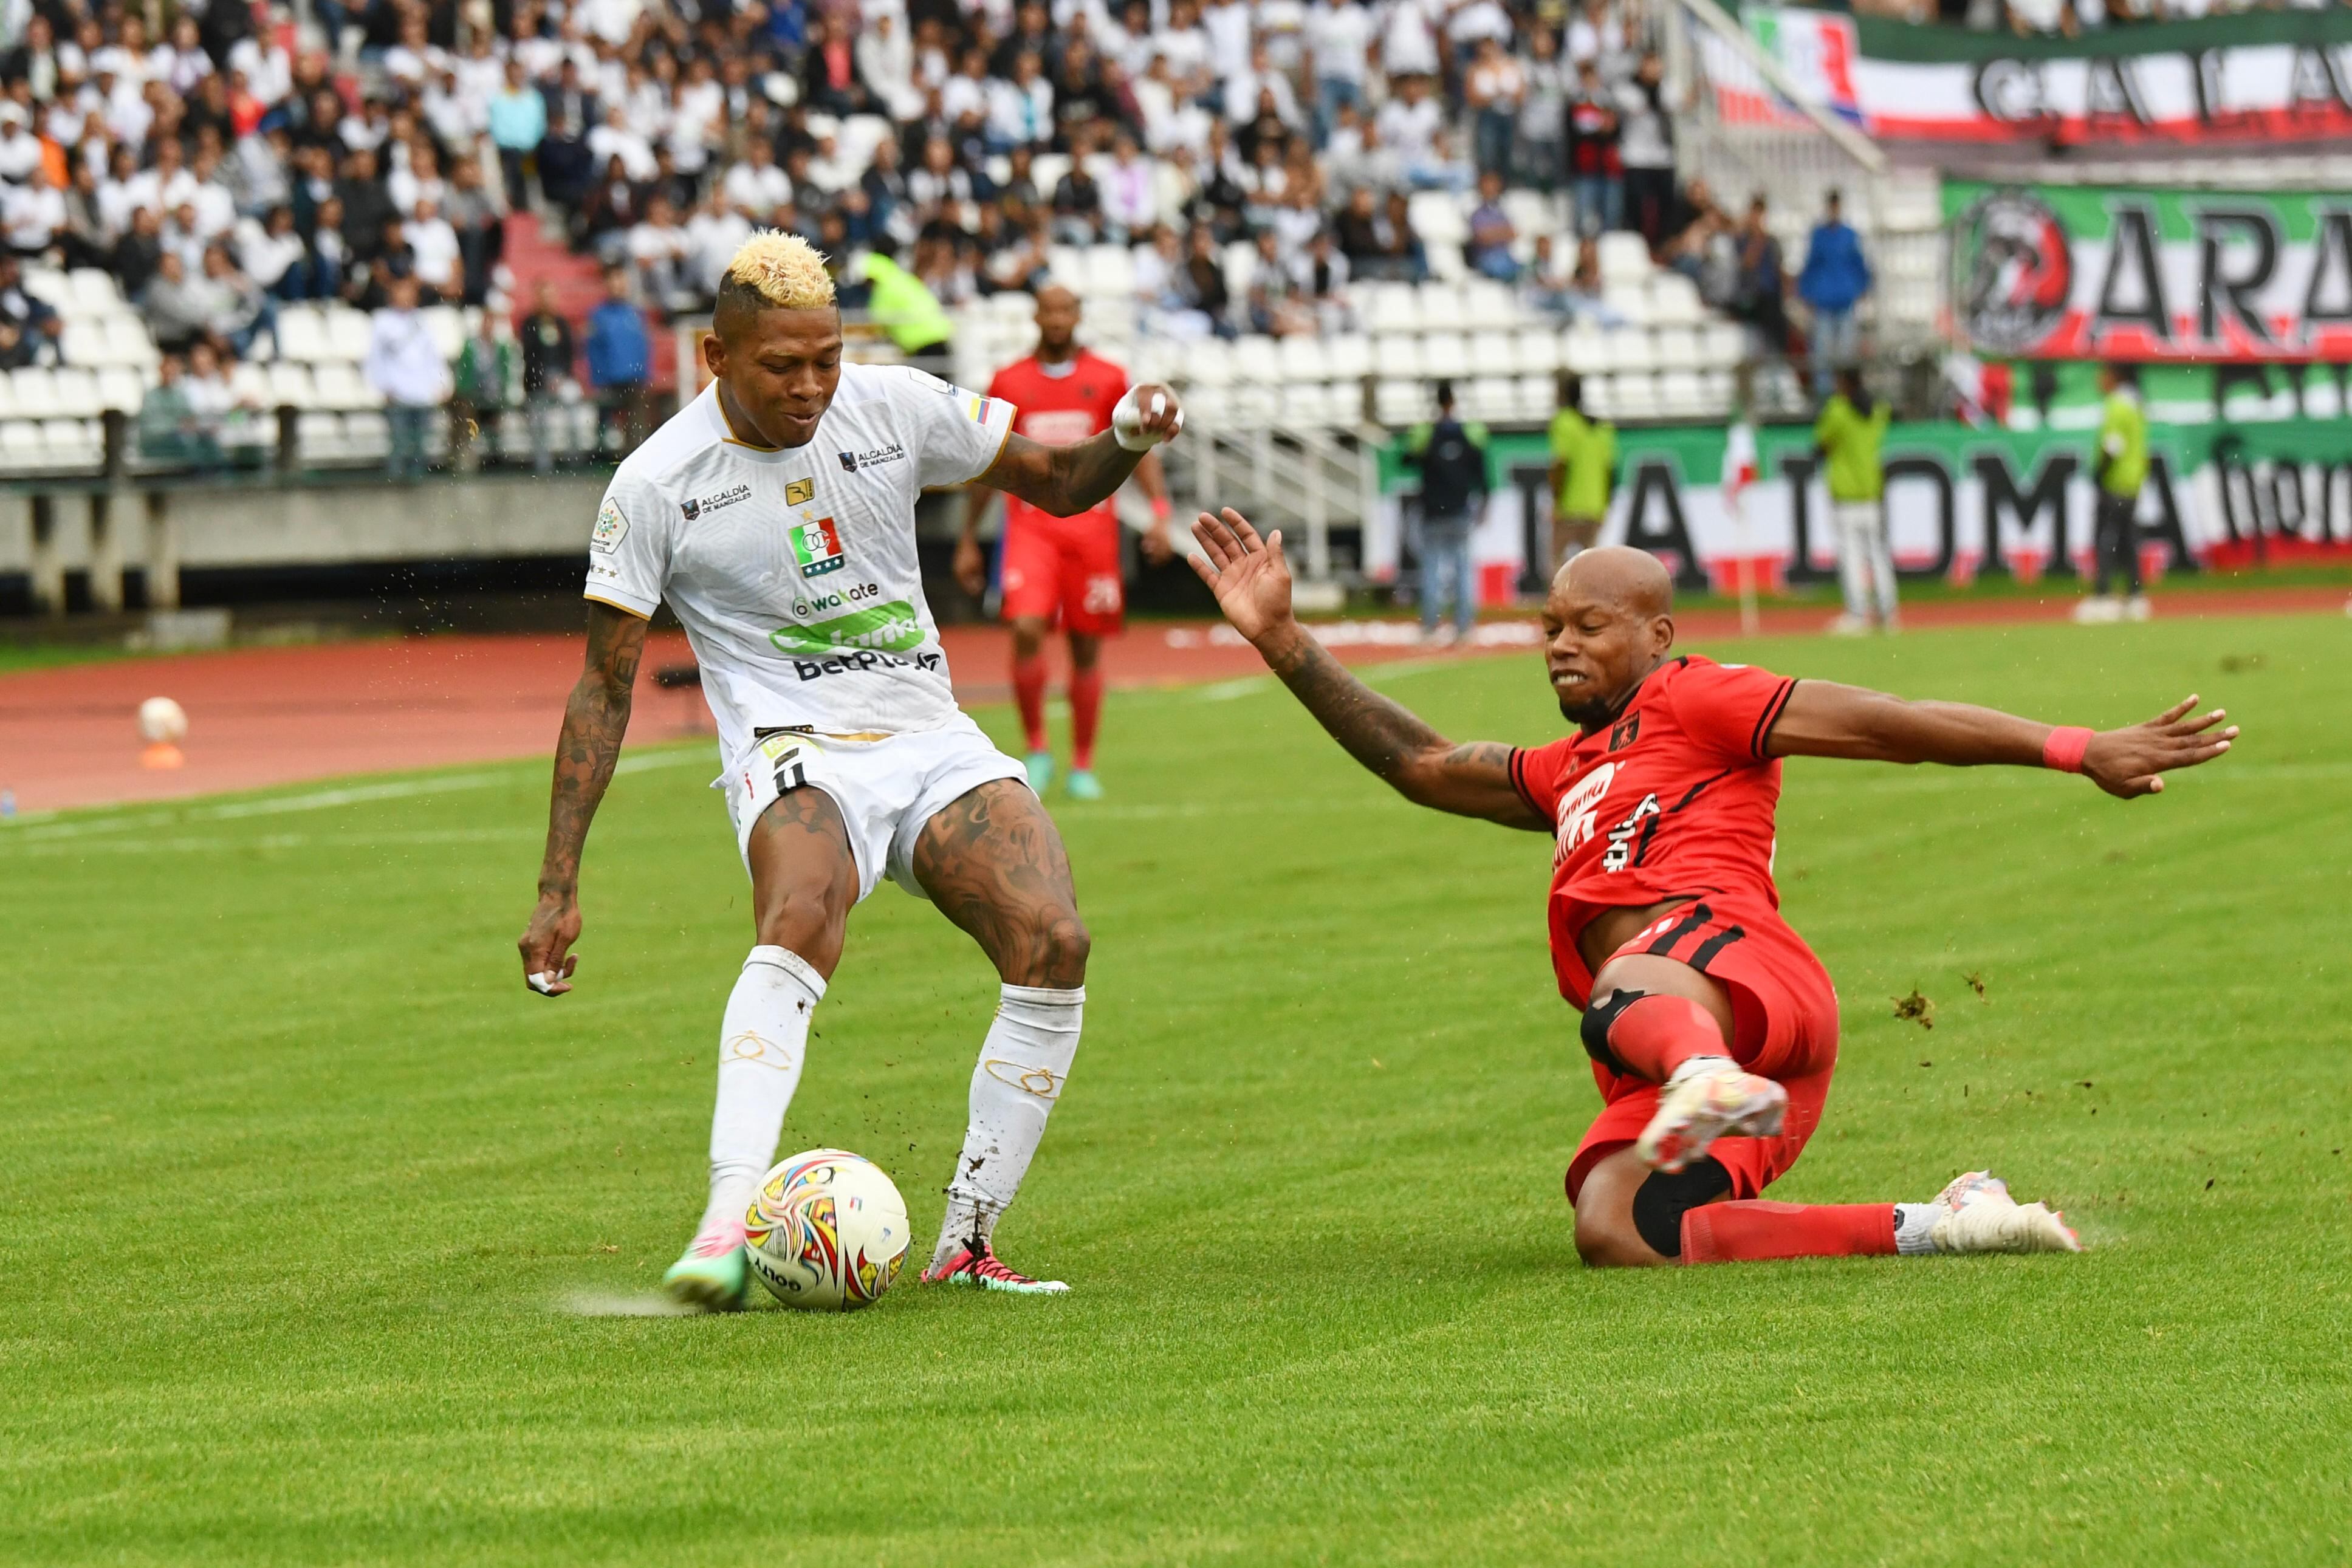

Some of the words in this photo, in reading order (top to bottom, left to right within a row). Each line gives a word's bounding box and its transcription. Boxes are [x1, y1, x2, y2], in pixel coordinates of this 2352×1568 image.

[859, 444, 902, 461] ALCALDÍA
[702, 485, 749, 507] ALCALDÍA
[714, 492, 752, 510] MANIZALES
[811, 583, 879, 612] wakate
[793, 650, 921, 682] BetPla
[755, 1256, 801, 1292] GOLTY
